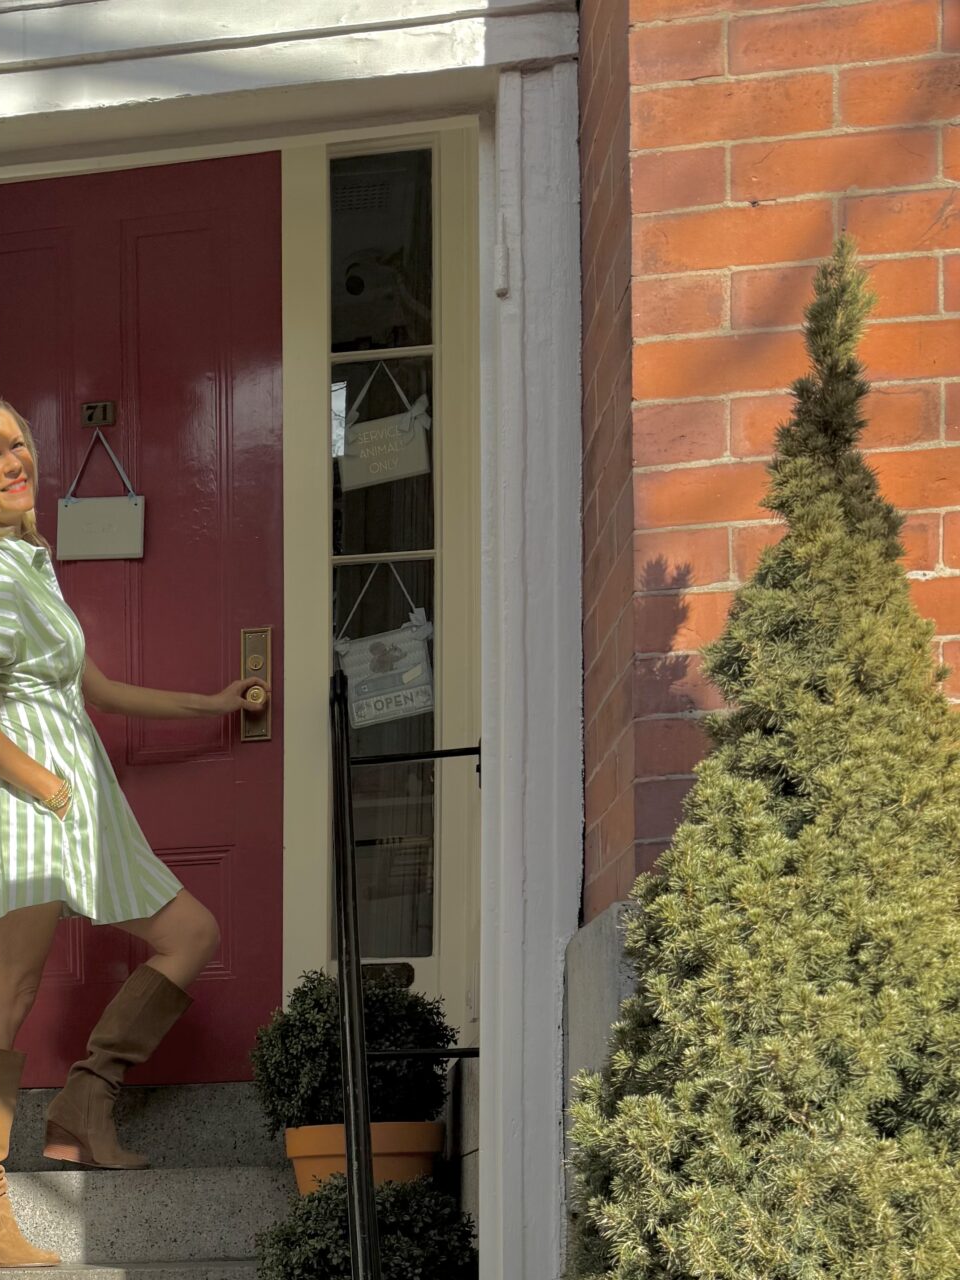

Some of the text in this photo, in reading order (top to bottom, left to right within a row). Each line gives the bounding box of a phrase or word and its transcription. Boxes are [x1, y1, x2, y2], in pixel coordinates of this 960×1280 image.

[85, 405, 108, 422] 71
[369, 455, 400, 474] ONLY
[373, 692, 415, 711] OPEN
